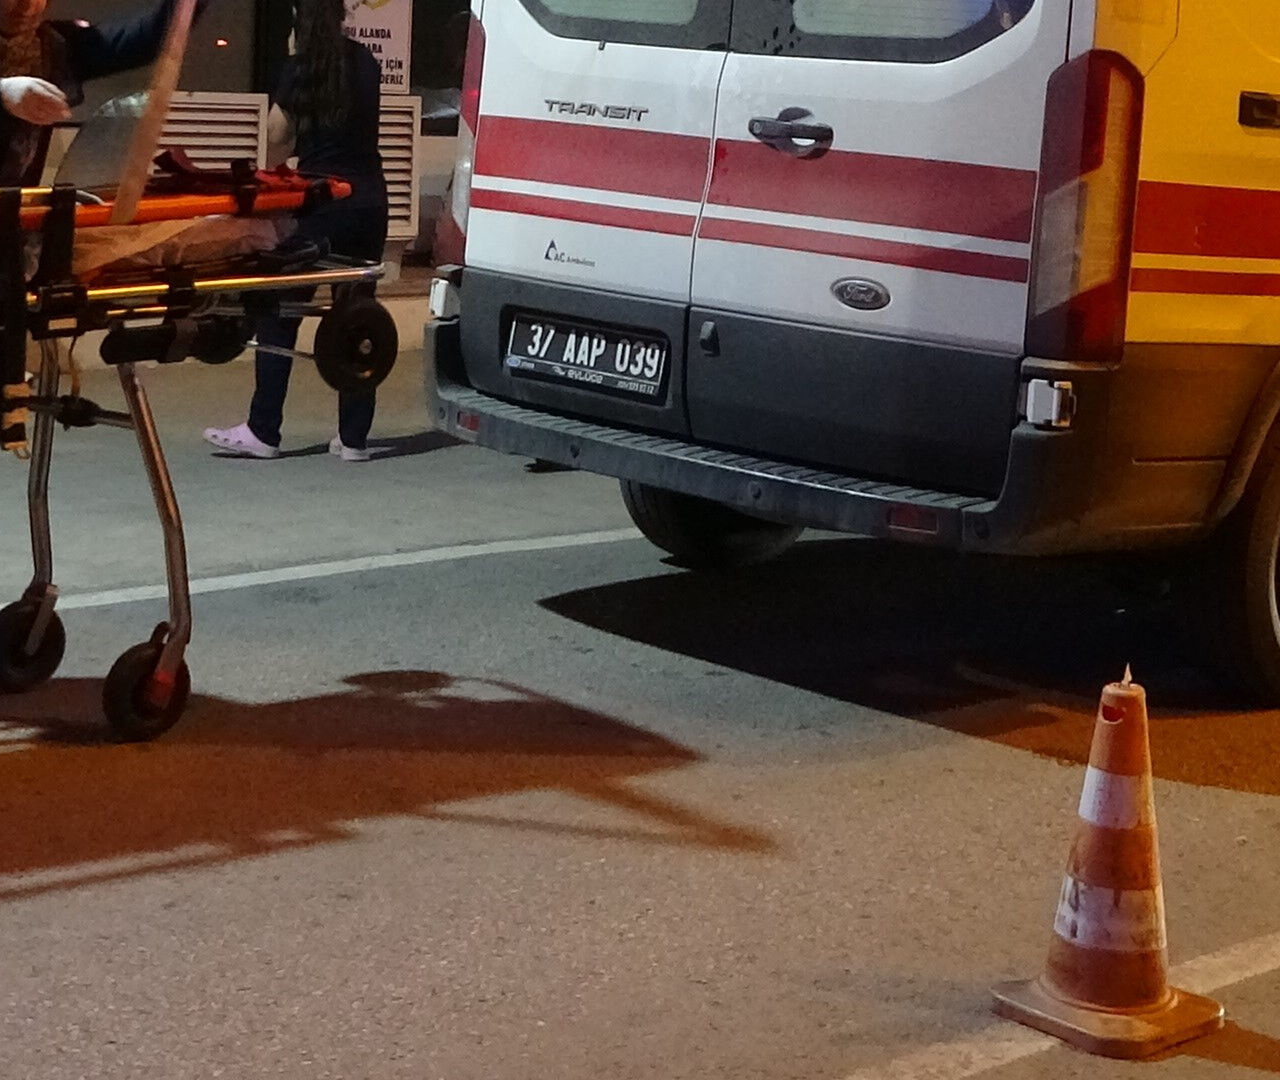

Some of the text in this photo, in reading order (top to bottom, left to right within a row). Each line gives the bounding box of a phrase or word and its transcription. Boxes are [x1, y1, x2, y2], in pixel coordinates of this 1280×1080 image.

[359, 27, 391, 39] ALANDA
[379, 73, 404, 86] DERİZ
[544, 98, 649, 123] TRANSIT
[527, 323, 660, 378] 37 AAP 039
